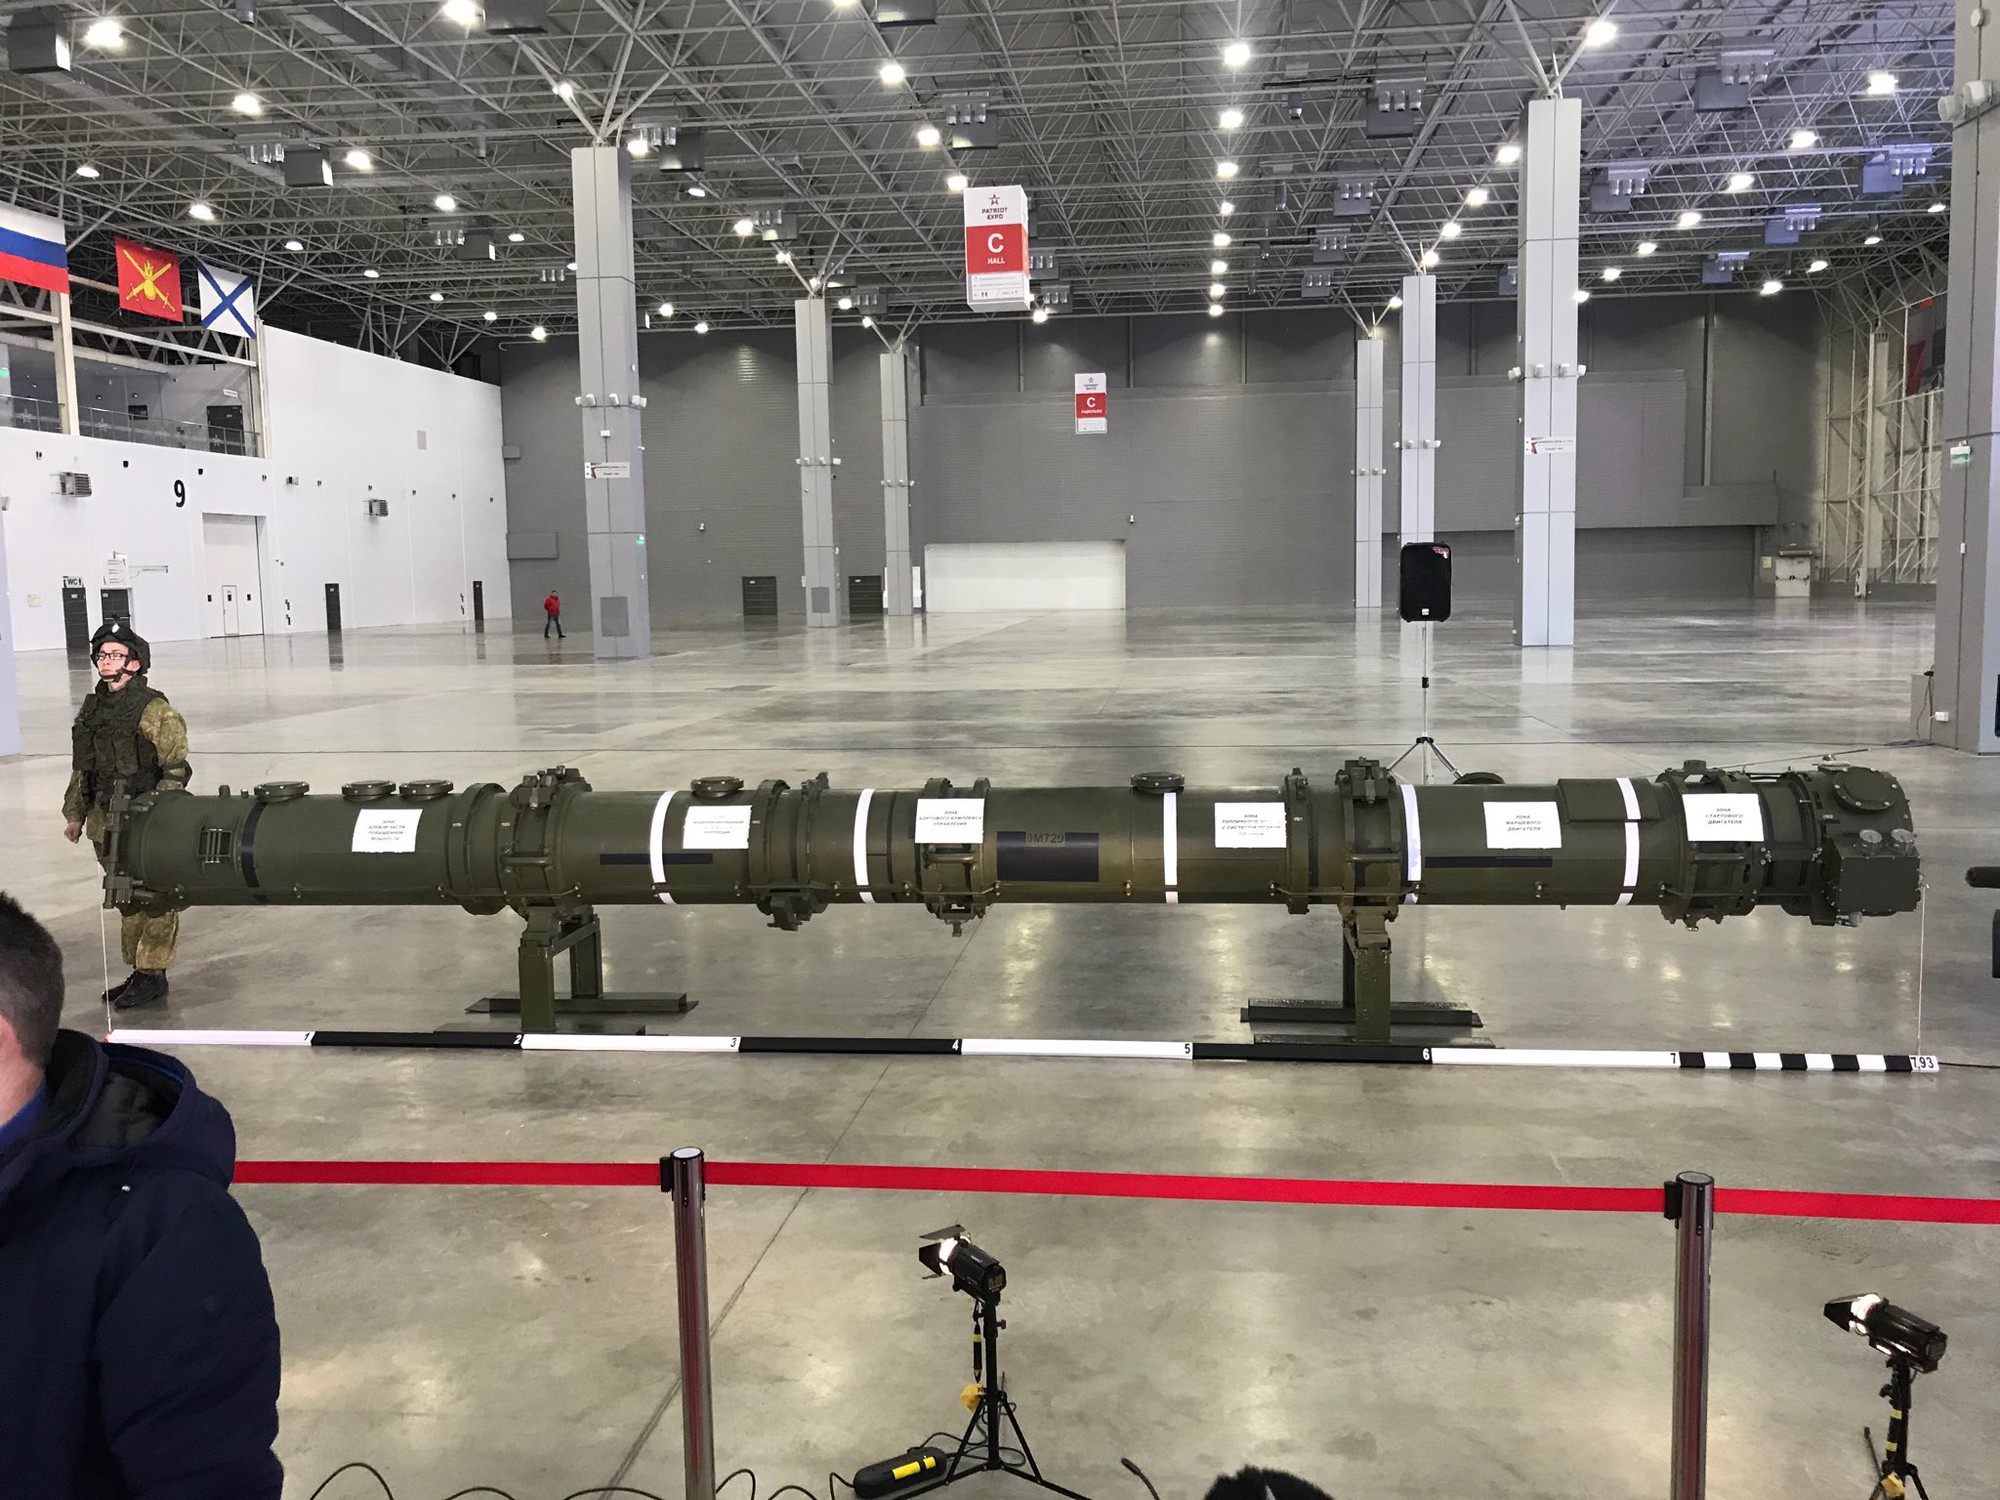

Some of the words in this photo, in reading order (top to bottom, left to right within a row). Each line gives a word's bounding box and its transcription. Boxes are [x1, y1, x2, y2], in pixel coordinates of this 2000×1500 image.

[987, 233, 1004, 253] C
[987, 257, 1006, 265] HALL
[173, 479, 186, 508] 9
[67, 578, 78, 586] WC
[304, 1032, 310, 1041] 1
[513, 1034, 522, 1044] 2
[730, 1037, 737, 1047] 3
[952, 1039, 959, 1050] 4
[1185, 1043, 1191, 1054] 5
[1422, 1047, 1430, 1061] 6
[1670, 1052, 1676, 1064] 7
